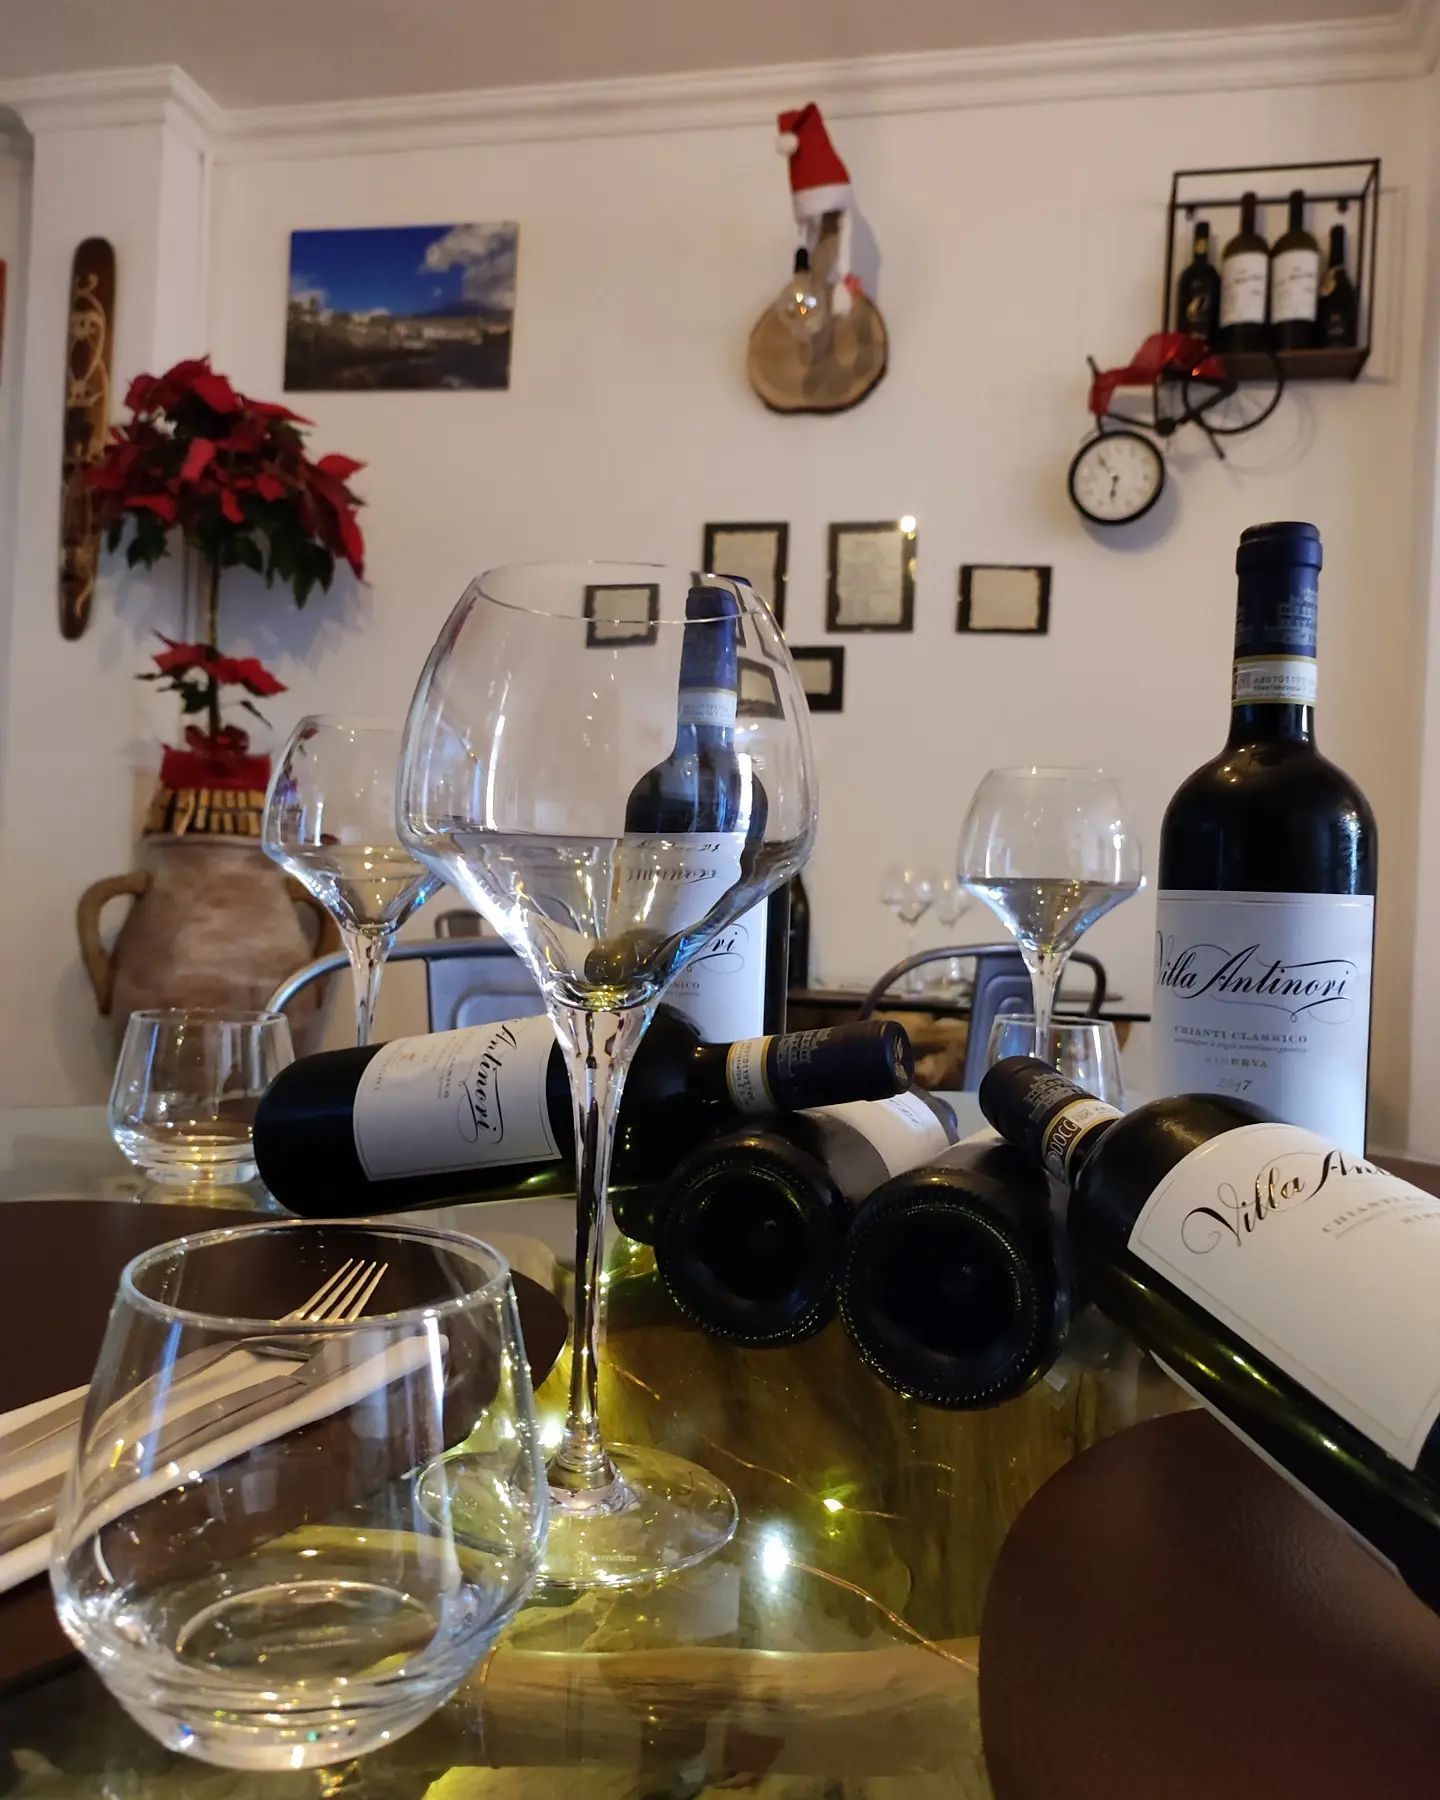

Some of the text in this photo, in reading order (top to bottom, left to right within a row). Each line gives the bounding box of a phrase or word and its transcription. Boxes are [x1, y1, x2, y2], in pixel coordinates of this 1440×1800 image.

[1174, 942, 1355, 1014] Antinori
[1173, 1025, 1308, 1044] CHIANTI CLASSICO
[461, 1022, 518, 1143] Antinori
[1049, 1118, 1080, 1157] DOCG
[1180, 1165, 1306, 1256] Villa
